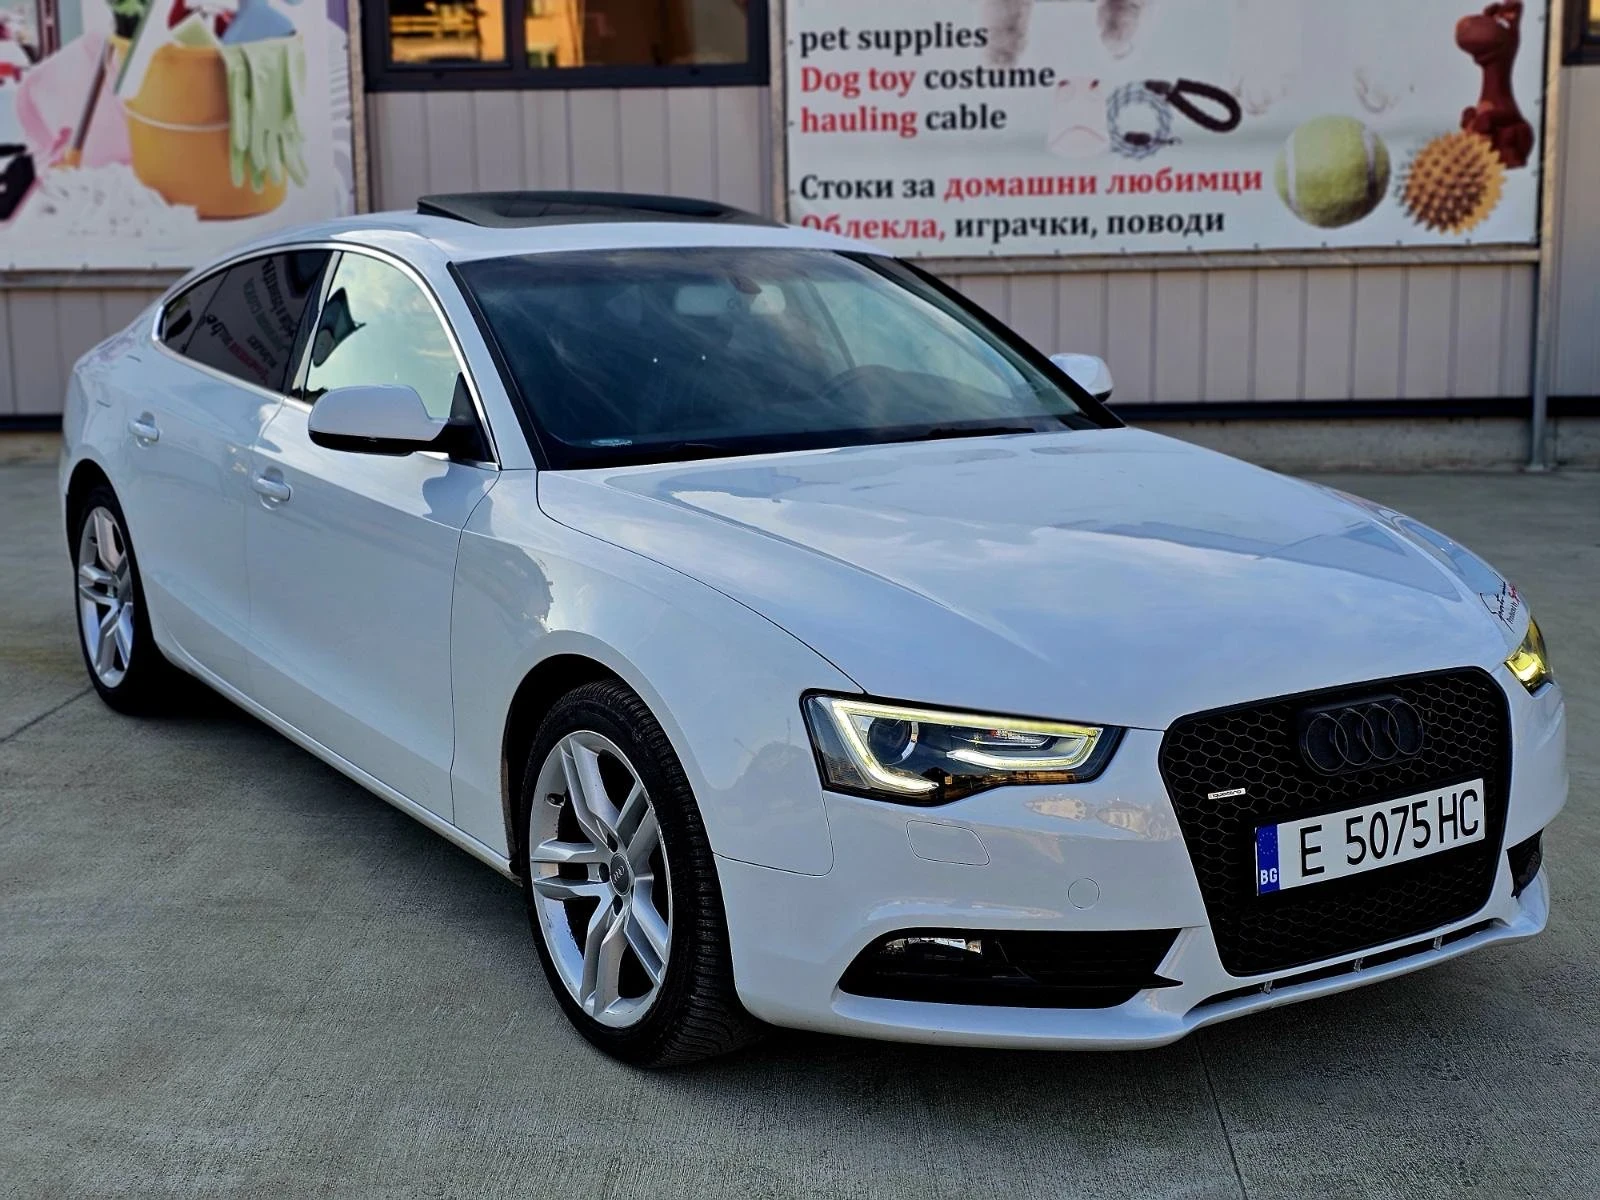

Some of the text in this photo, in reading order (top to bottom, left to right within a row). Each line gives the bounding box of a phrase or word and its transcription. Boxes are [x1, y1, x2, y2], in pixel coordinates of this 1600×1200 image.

[800, 22, 989, 58] pet supplies
[800, 65, 1056, 98] Dog toy costume
[800, 104, 1007, 137] hauling cable
[800, 167, 1263, 203] Стоки за домашни любимци
[955, 216, 1098, 242] играчки,
[1107, 212, 1224, 236] поводи
[1300, 824, 1325, 877] E
[1260, 867, 1278, 885] BG
